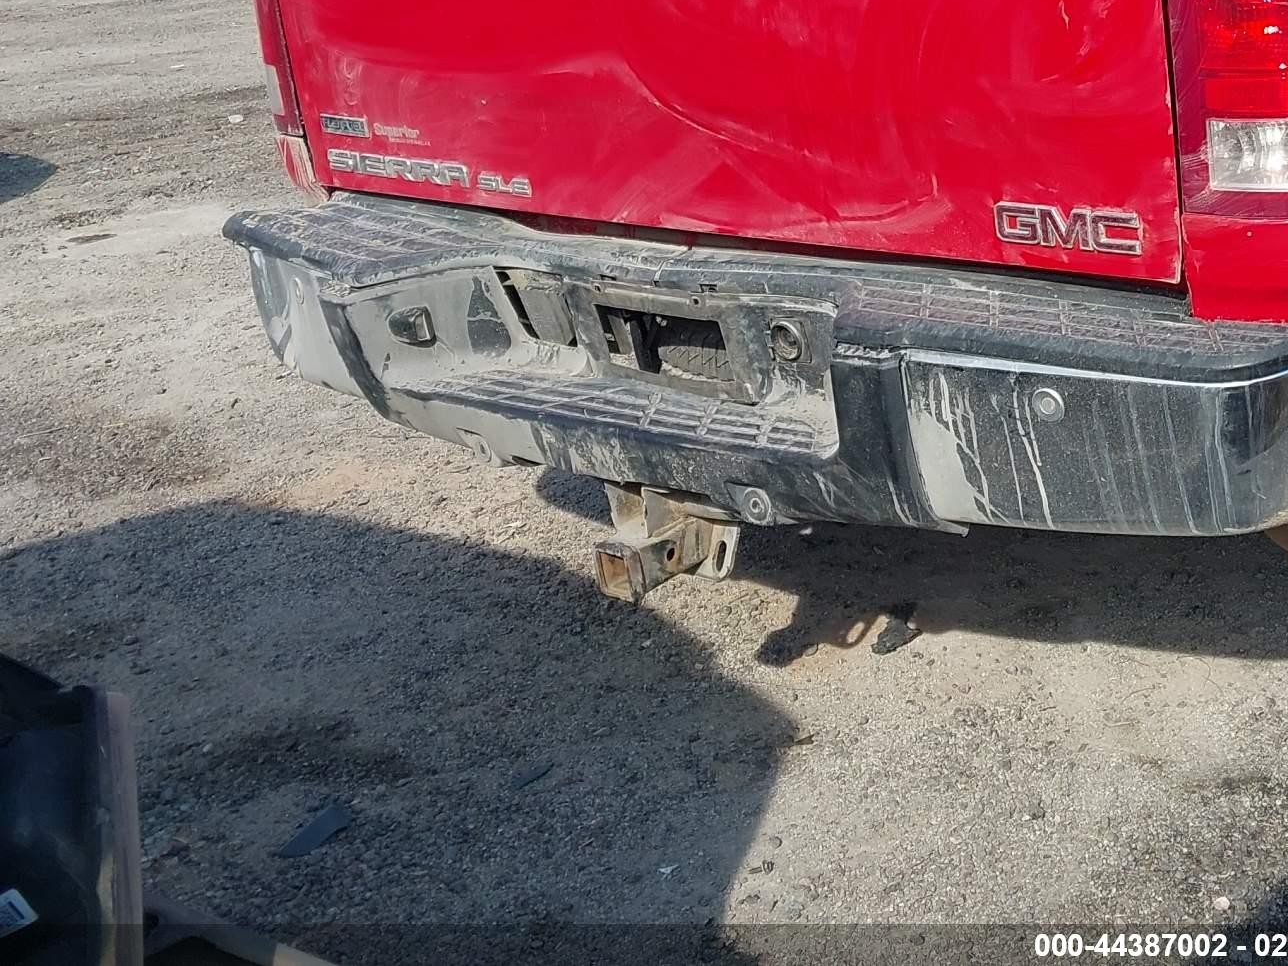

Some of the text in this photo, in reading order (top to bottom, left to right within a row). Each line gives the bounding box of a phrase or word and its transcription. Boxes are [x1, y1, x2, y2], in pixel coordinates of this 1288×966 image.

[328, 148, 533, 198] SIERRA SLE
[994, 201, 1143, 256] GMC
